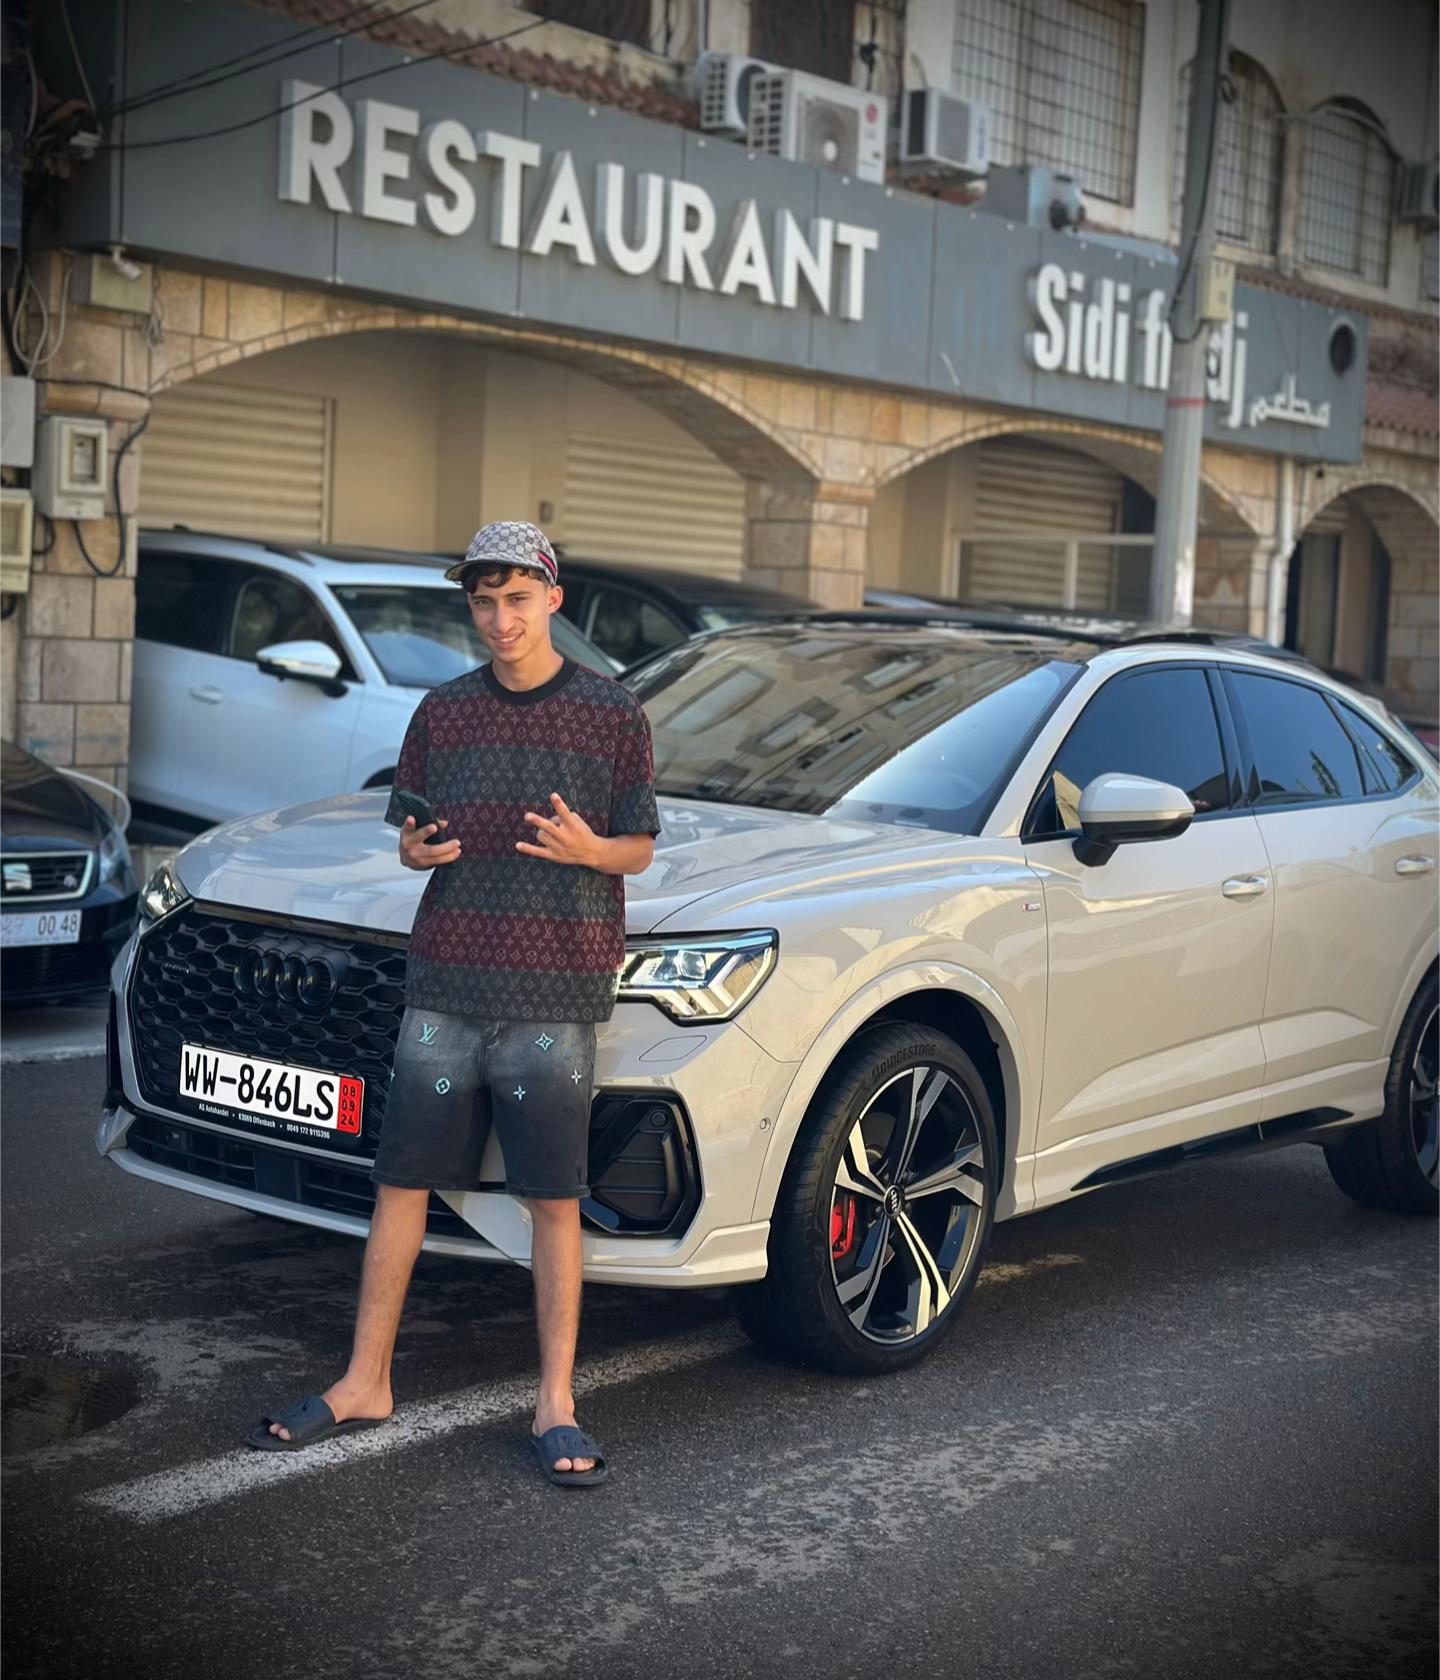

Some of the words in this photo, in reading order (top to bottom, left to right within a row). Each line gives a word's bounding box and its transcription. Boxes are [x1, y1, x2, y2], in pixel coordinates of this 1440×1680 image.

[278, 79, 879, 322] RESTAURANT
[1030, 263, 1131, 383] Sidi
[1139, 289, 1248, 429] frdj
[1251, 374, 1330, 428] مطعم
[60, 913, 79, 934] 48
[185, 1051, 335, 1121] WW-846LS
[342, 1084, 356, 1097] 08
[206, 1104, 229, 1118] Autohandel
[253, 1115, 276, 1128] Offenbach
[300, 1126, 309, 1136] 172
[340, 1114, 355, 1127] 24
[341, 1098, 355, 1112] 09
